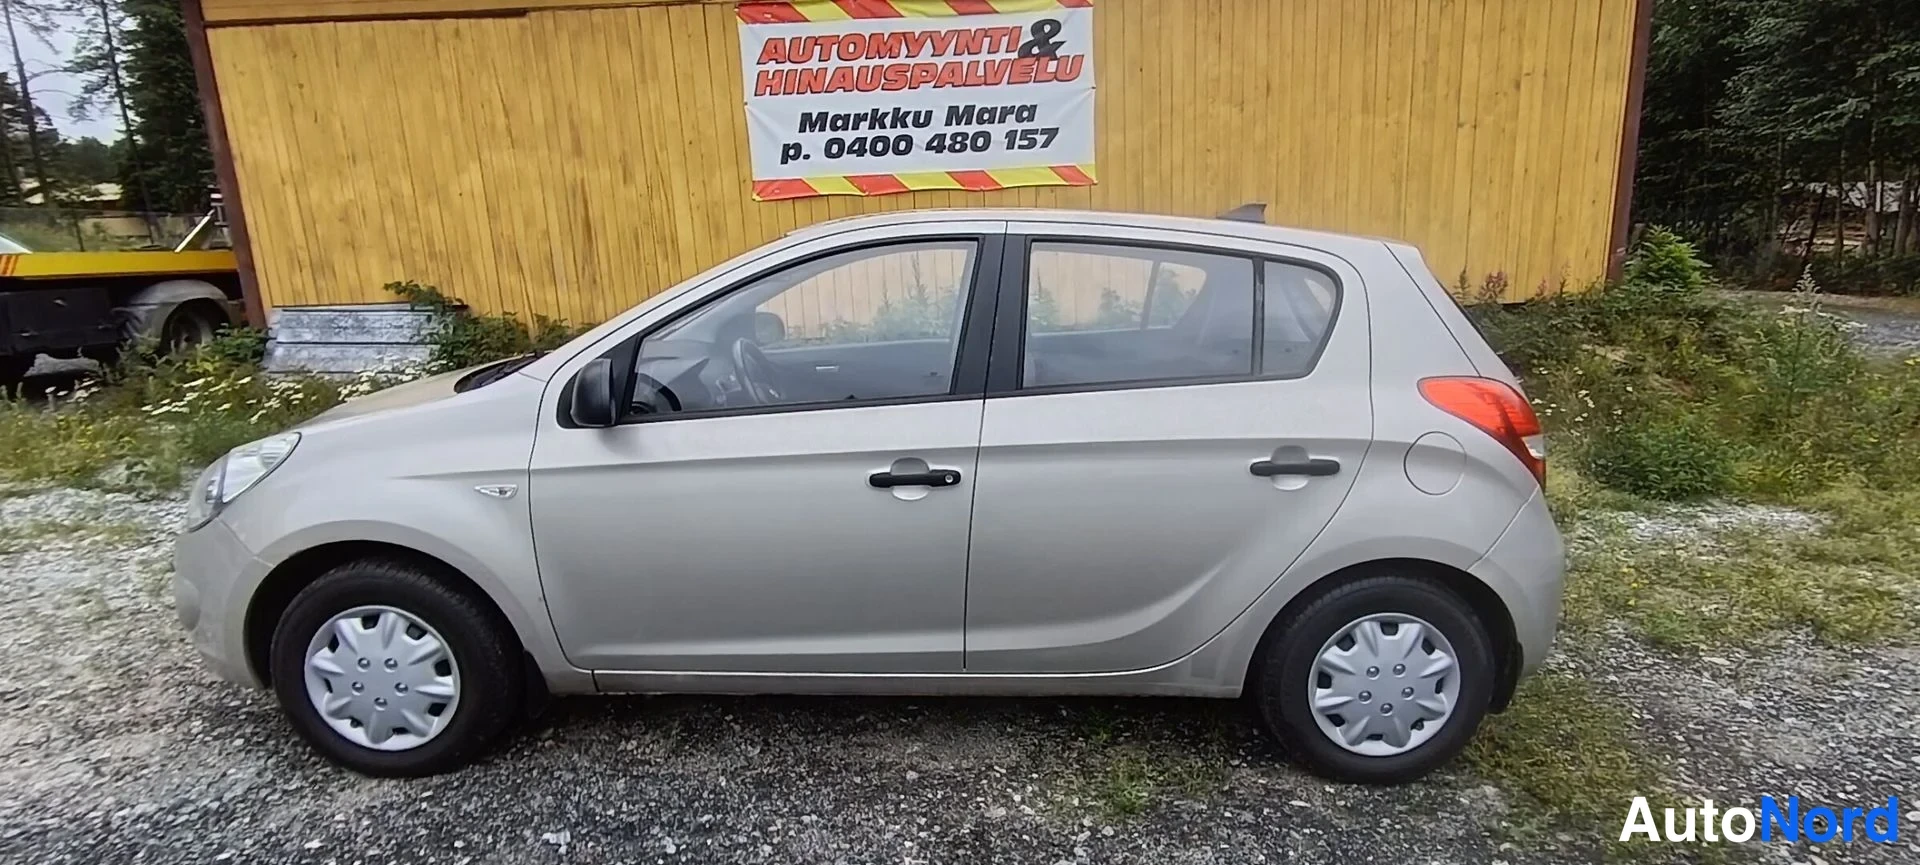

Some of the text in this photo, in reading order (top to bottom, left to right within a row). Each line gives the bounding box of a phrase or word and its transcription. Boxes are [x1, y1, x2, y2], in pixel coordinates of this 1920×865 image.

[757, 18, 1068, 65] AUTOMYYNTI &
[754, 54, 1086, 96] HINAUSPALVELU
[798, 104, 1038, 133] Markku Mara
[780, 127, 1060, 165] p. 0400 480 157
